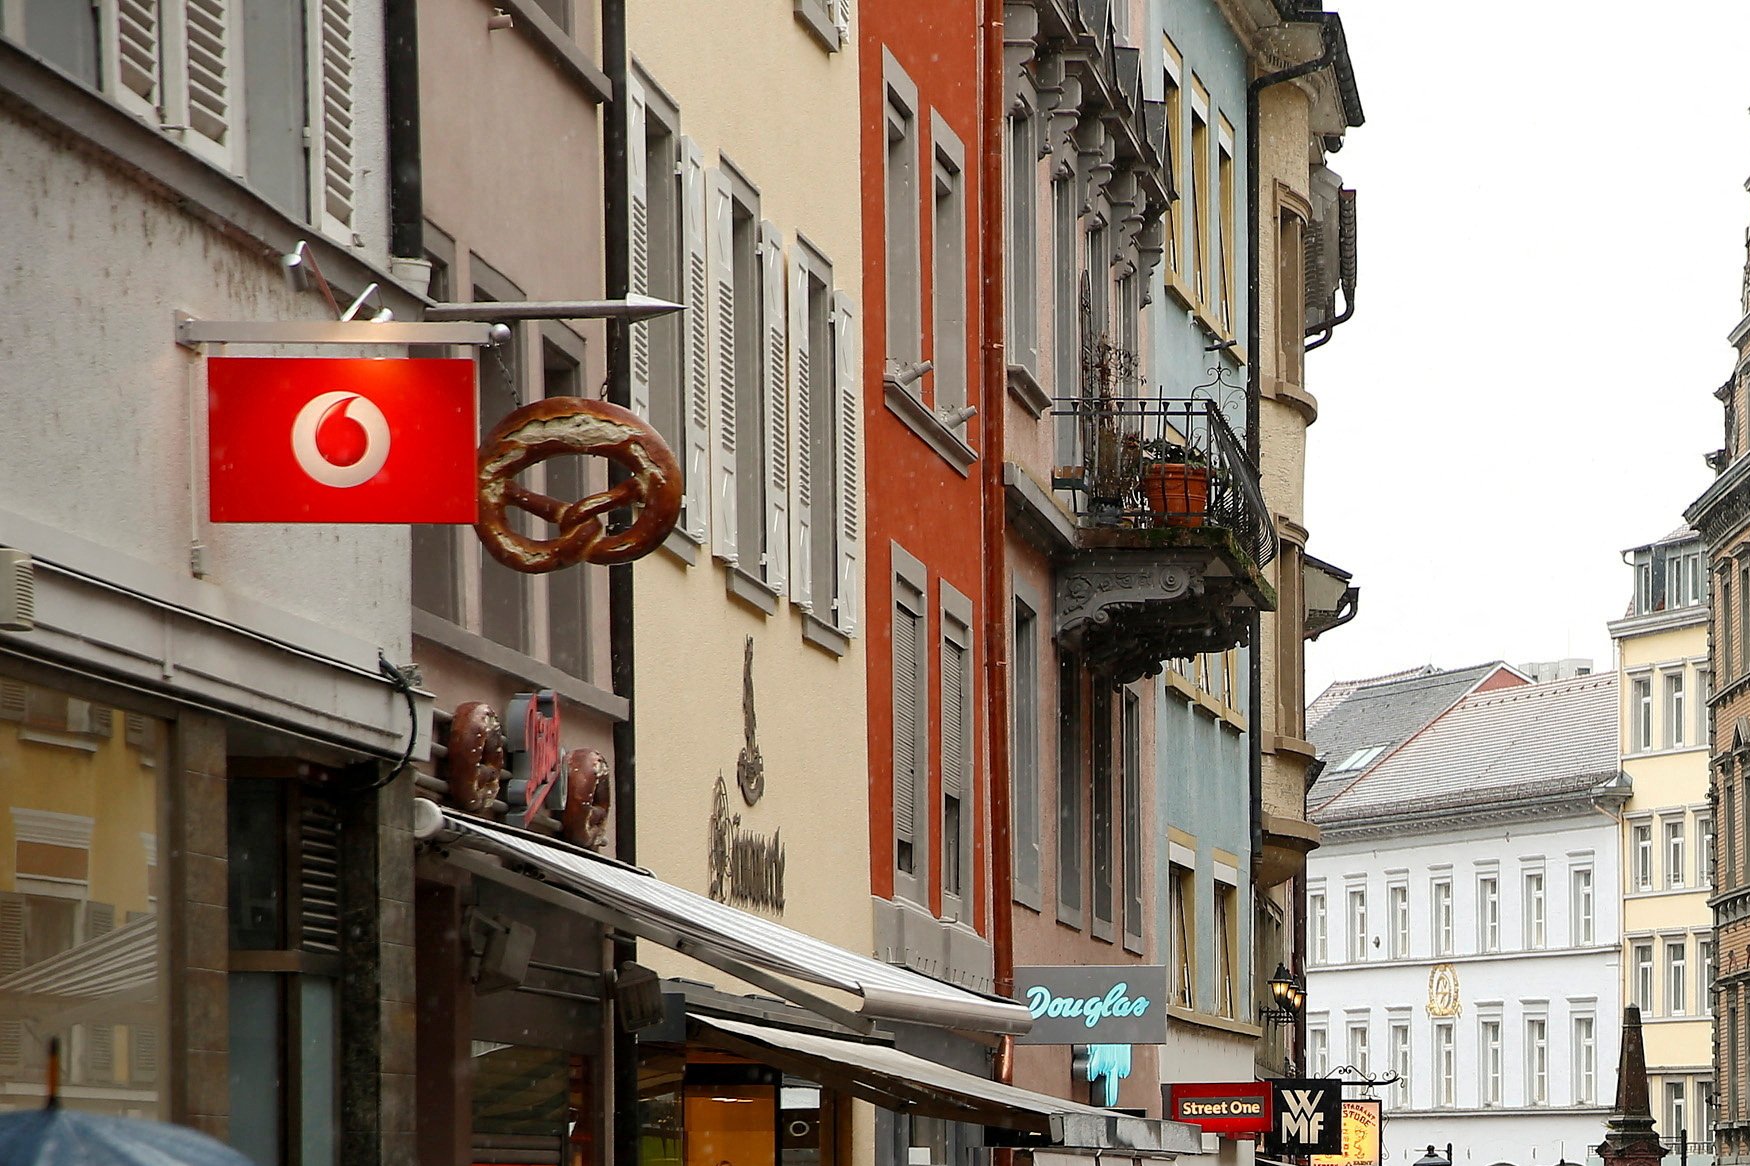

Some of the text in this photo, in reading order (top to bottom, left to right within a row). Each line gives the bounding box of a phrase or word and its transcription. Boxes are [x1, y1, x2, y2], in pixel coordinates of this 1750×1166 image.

[1026, 981, 1150, 1029] Douglas
[1182, 1100, 1261, 1115] Street One
